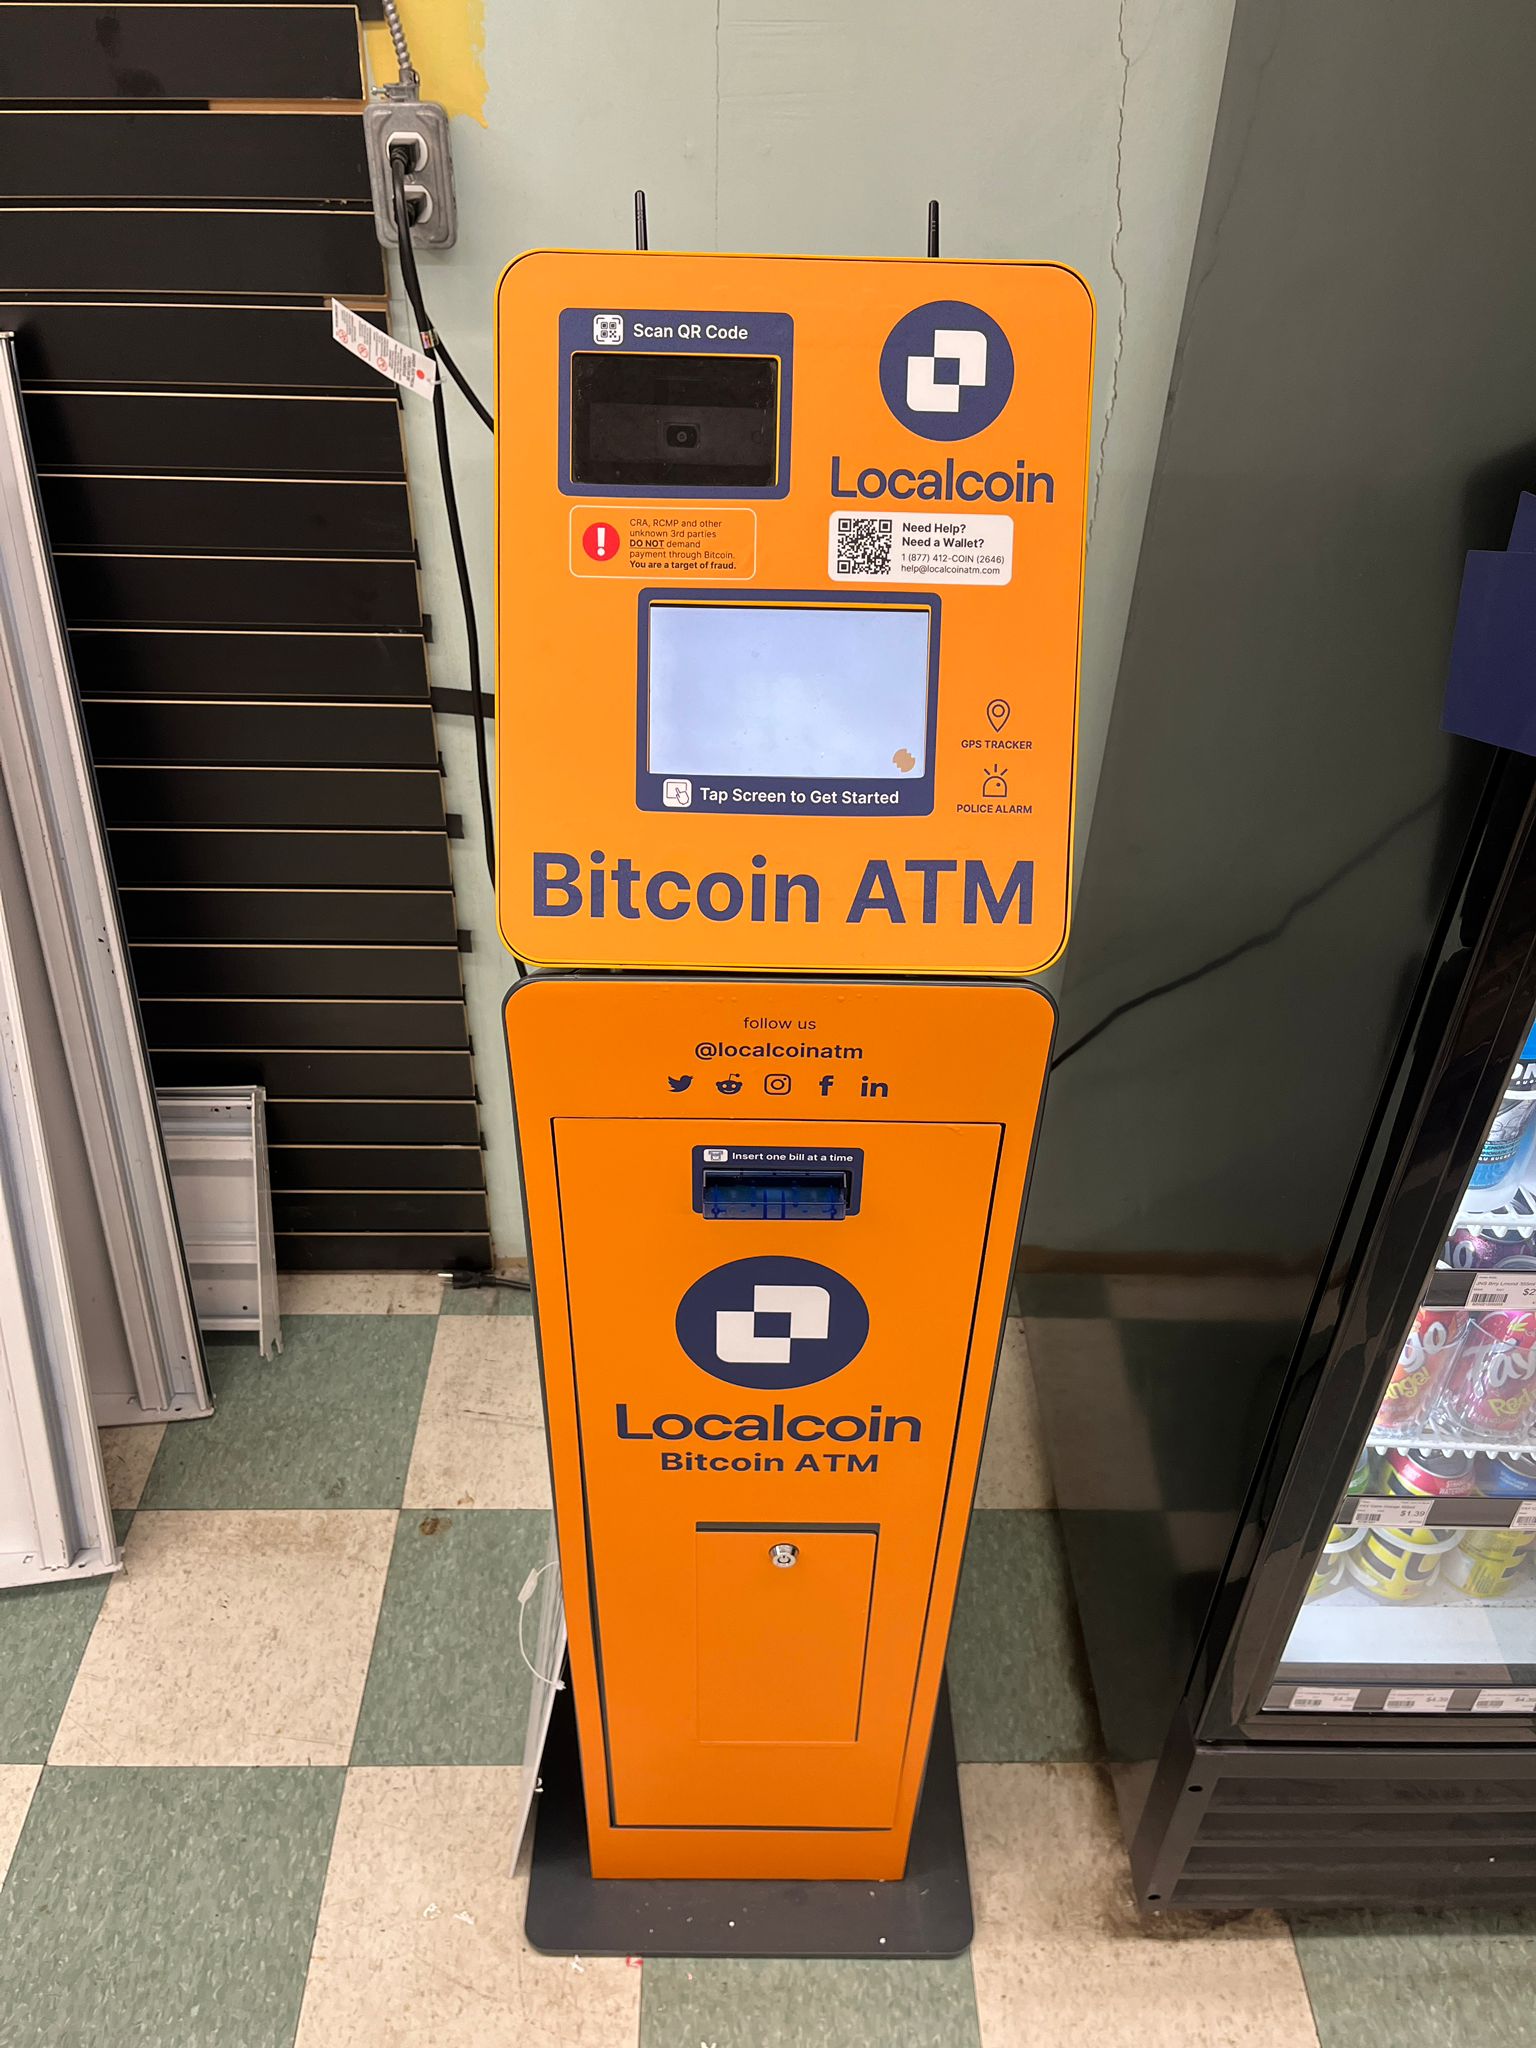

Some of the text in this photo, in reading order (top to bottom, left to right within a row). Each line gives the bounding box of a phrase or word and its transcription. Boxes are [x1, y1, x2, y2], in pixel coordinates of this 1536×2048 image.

[633, 323, 749, 342] Scan QR Code
[830, 455, 1055, 503] Localcoin
[630, 518, 722, 528] CRA, RCMP and other
[630, 529, 716, 540] unknown 3rd parties
[902, 523, 966, 536] Need Help?
[630, 540, 701, 548] DO NOT demand
[902, 536, 931, 547] Need
[943, 537, 984, 548] Wallet?
[630, 551, 735, 560] payment through Bitcoin.
[902, 554, 1005, 564] 1 (877) 412-COIN (2646)
[630, 561, 646, 569] You
[671, 562, 698, 570] target
[699, 561, 709, 569] of
[710, 561, 737, 570] fraud.
[901, 564, 1000, 576] help@localcoinatm.com
[961, 740, 1033, 750] GPS TRACKER
[700, 787, 899, 804] Tap Screen to Get Started
[956, 804, 1033, 814] POLICE ALARM
[532, 849, 1035, 925] Bitcoin ATM
[744, 1016, 816, 1030] follow us
[694, 1042, 863, 1061] @localcoinatm
[732, 1152, 764, 1161] Insert
[789, 1153, 805, 1161] bill
[807, 1154, 818, 1162] at
[829, 1154, 854, 1162] time
[616, 1403, 922, 1443] Localcoin
[660, 1452, 879, 1473] Bitcoin ATM
